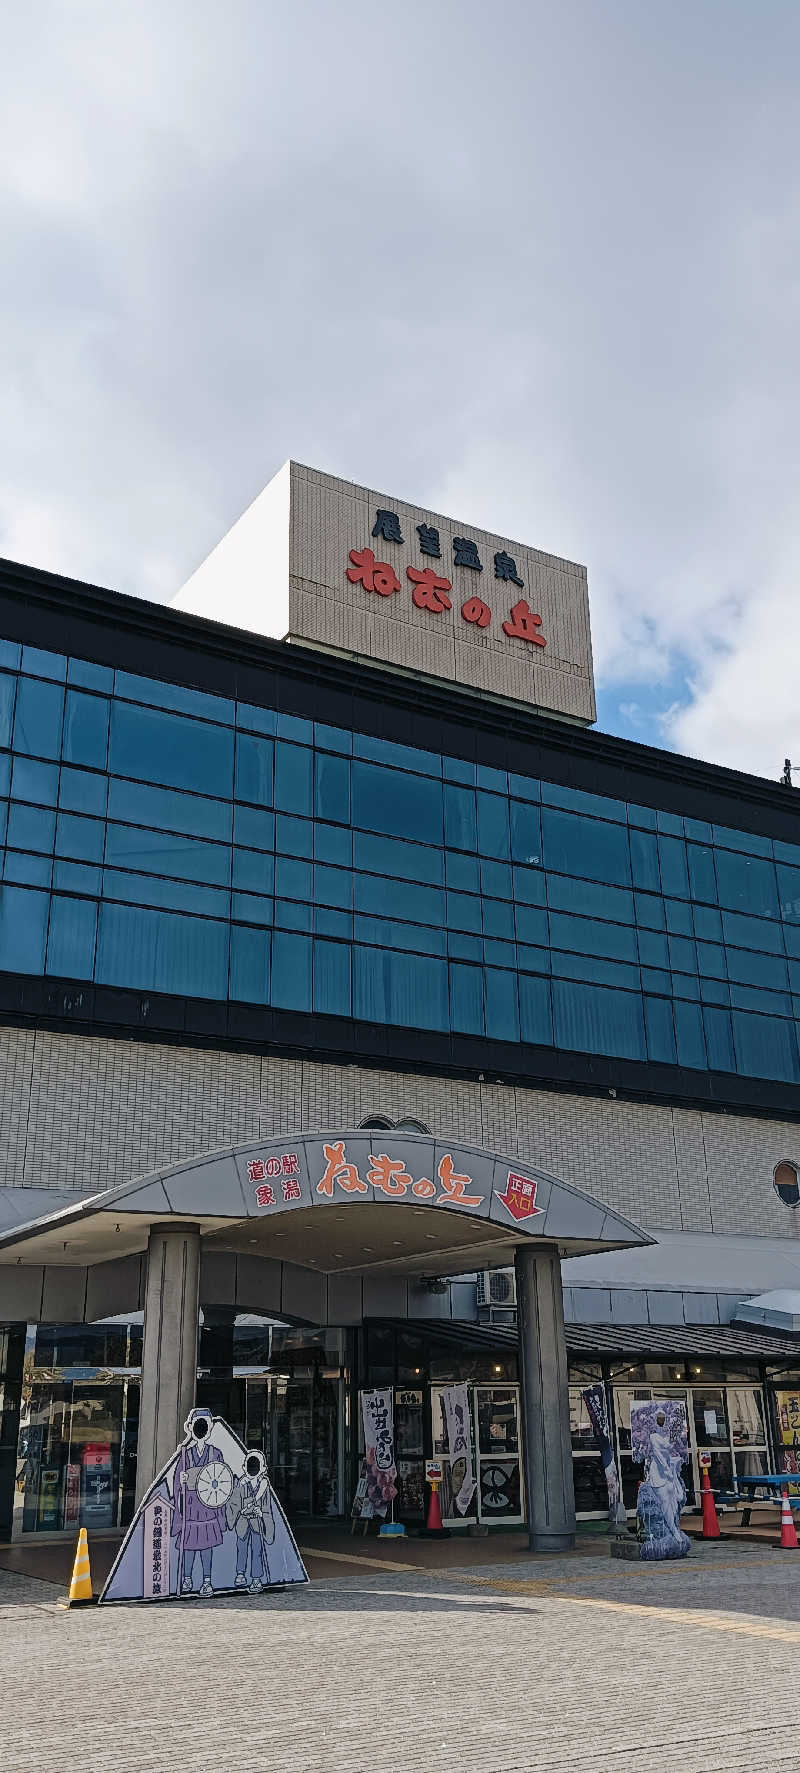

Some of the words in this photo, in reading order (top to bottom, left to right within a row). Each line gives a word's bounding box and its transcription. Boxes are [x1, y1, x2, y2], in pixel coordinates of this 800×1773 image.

[371, 508, 525, 589] 展望温泉
[346, 547, 547, 648] ねむの丘
[247, 1153, 301, 1182] 道の駅
[316, 1141, 485, 1206] ねむの丘
[255, 1180, 302, 1207] 象潟
[511, 1177, 534, 1197] 正面
[508, 1192, 531, 1212] 入口
